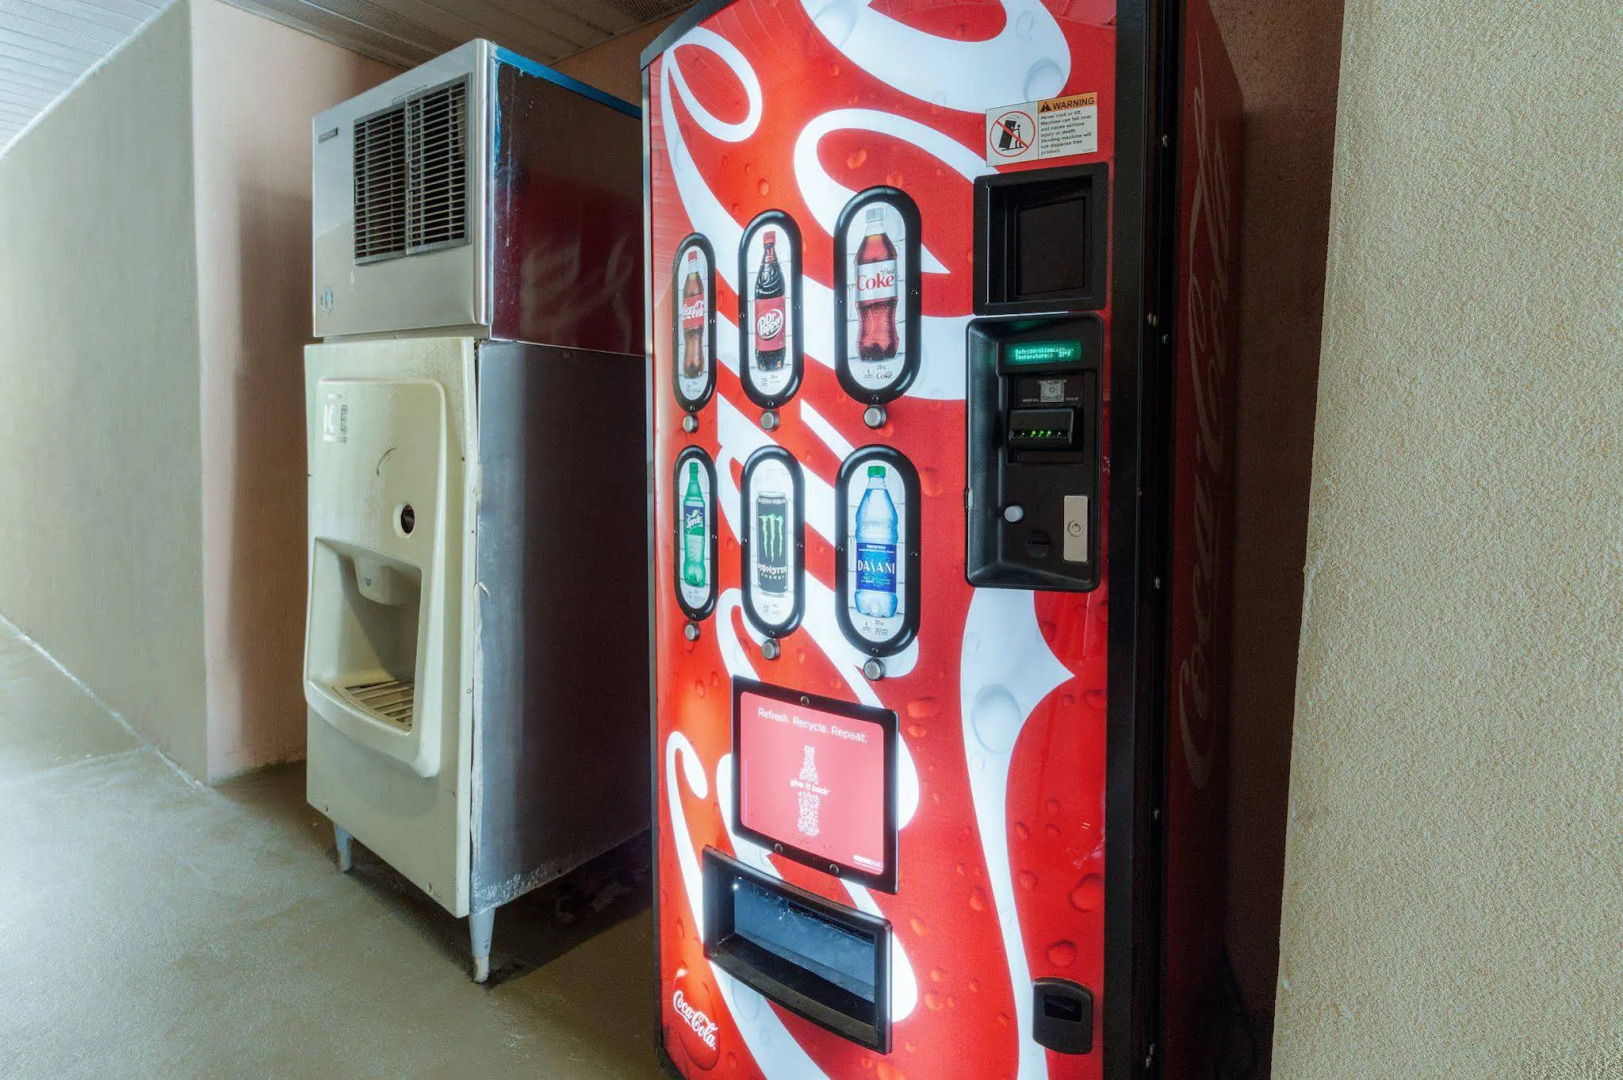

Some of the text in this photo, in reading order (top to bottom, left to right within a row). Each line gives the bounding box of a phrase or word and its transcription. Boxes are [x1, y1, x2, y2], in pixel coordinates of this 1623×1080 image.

[1053, 97, 1095, 110] WARNING
[857, 273, 894, 291] Coke
[759, 316, 781, 336] Pepper
[758, 563, 788, 575] MONSTER
[857, 558, 895, 574] DASANI
[758, 708, 867, 743] Refresh. Recycle. Repeat.
[673, 990, 718, 1049] Coca-Cola
